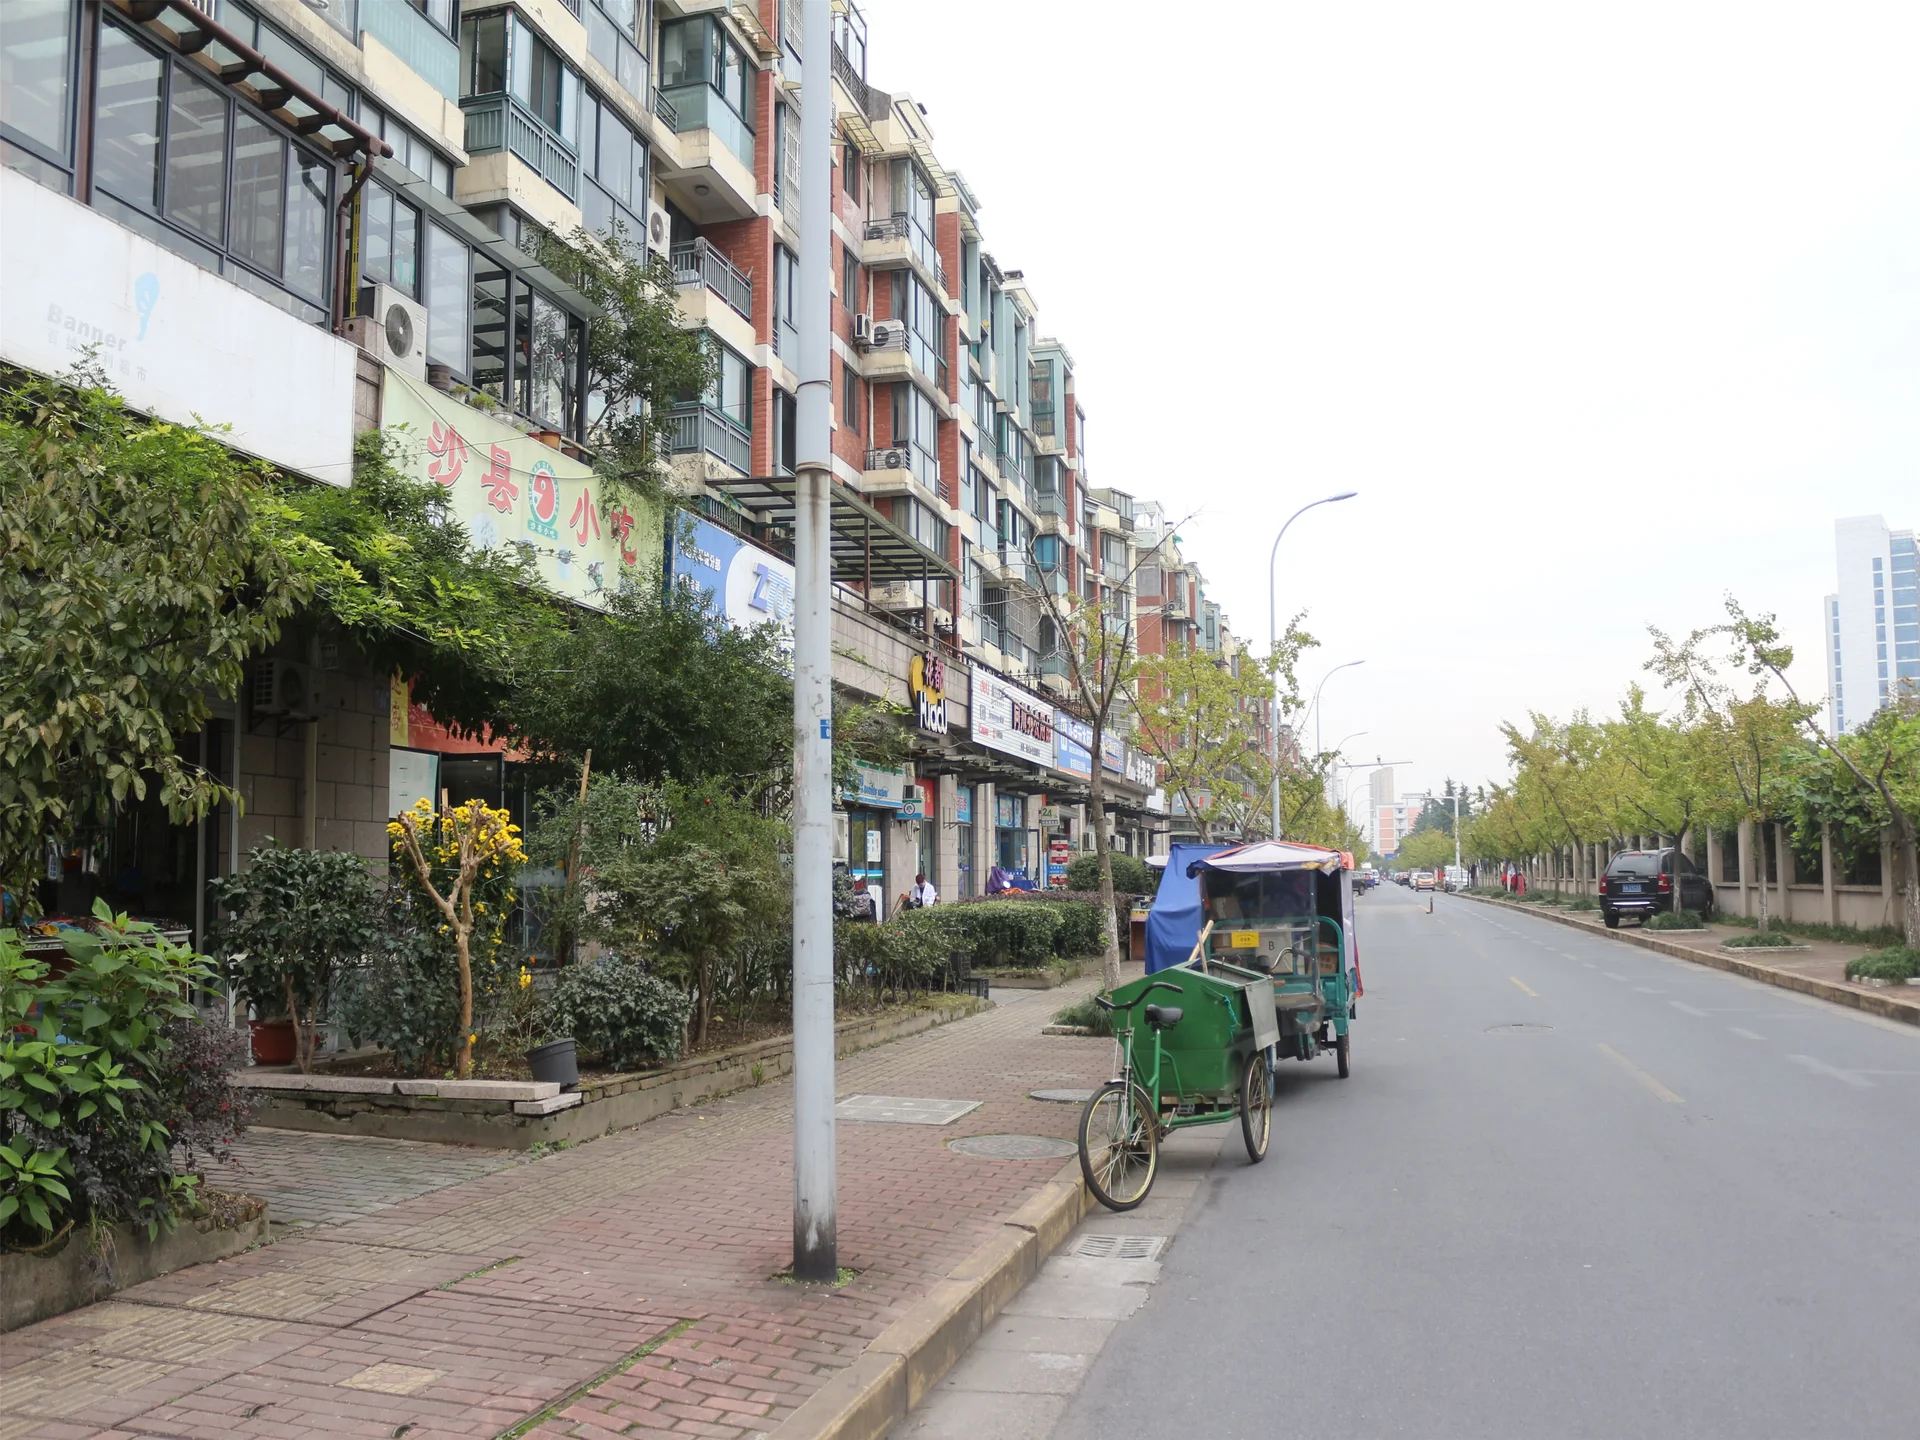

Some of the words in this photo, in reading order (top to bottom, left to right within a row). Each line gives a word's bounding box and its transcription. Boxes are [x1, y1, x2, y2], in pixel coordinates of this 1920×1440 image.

[47, 302, 127, 352] Banner
[47, 328, 148, 382] 百纳利超市
